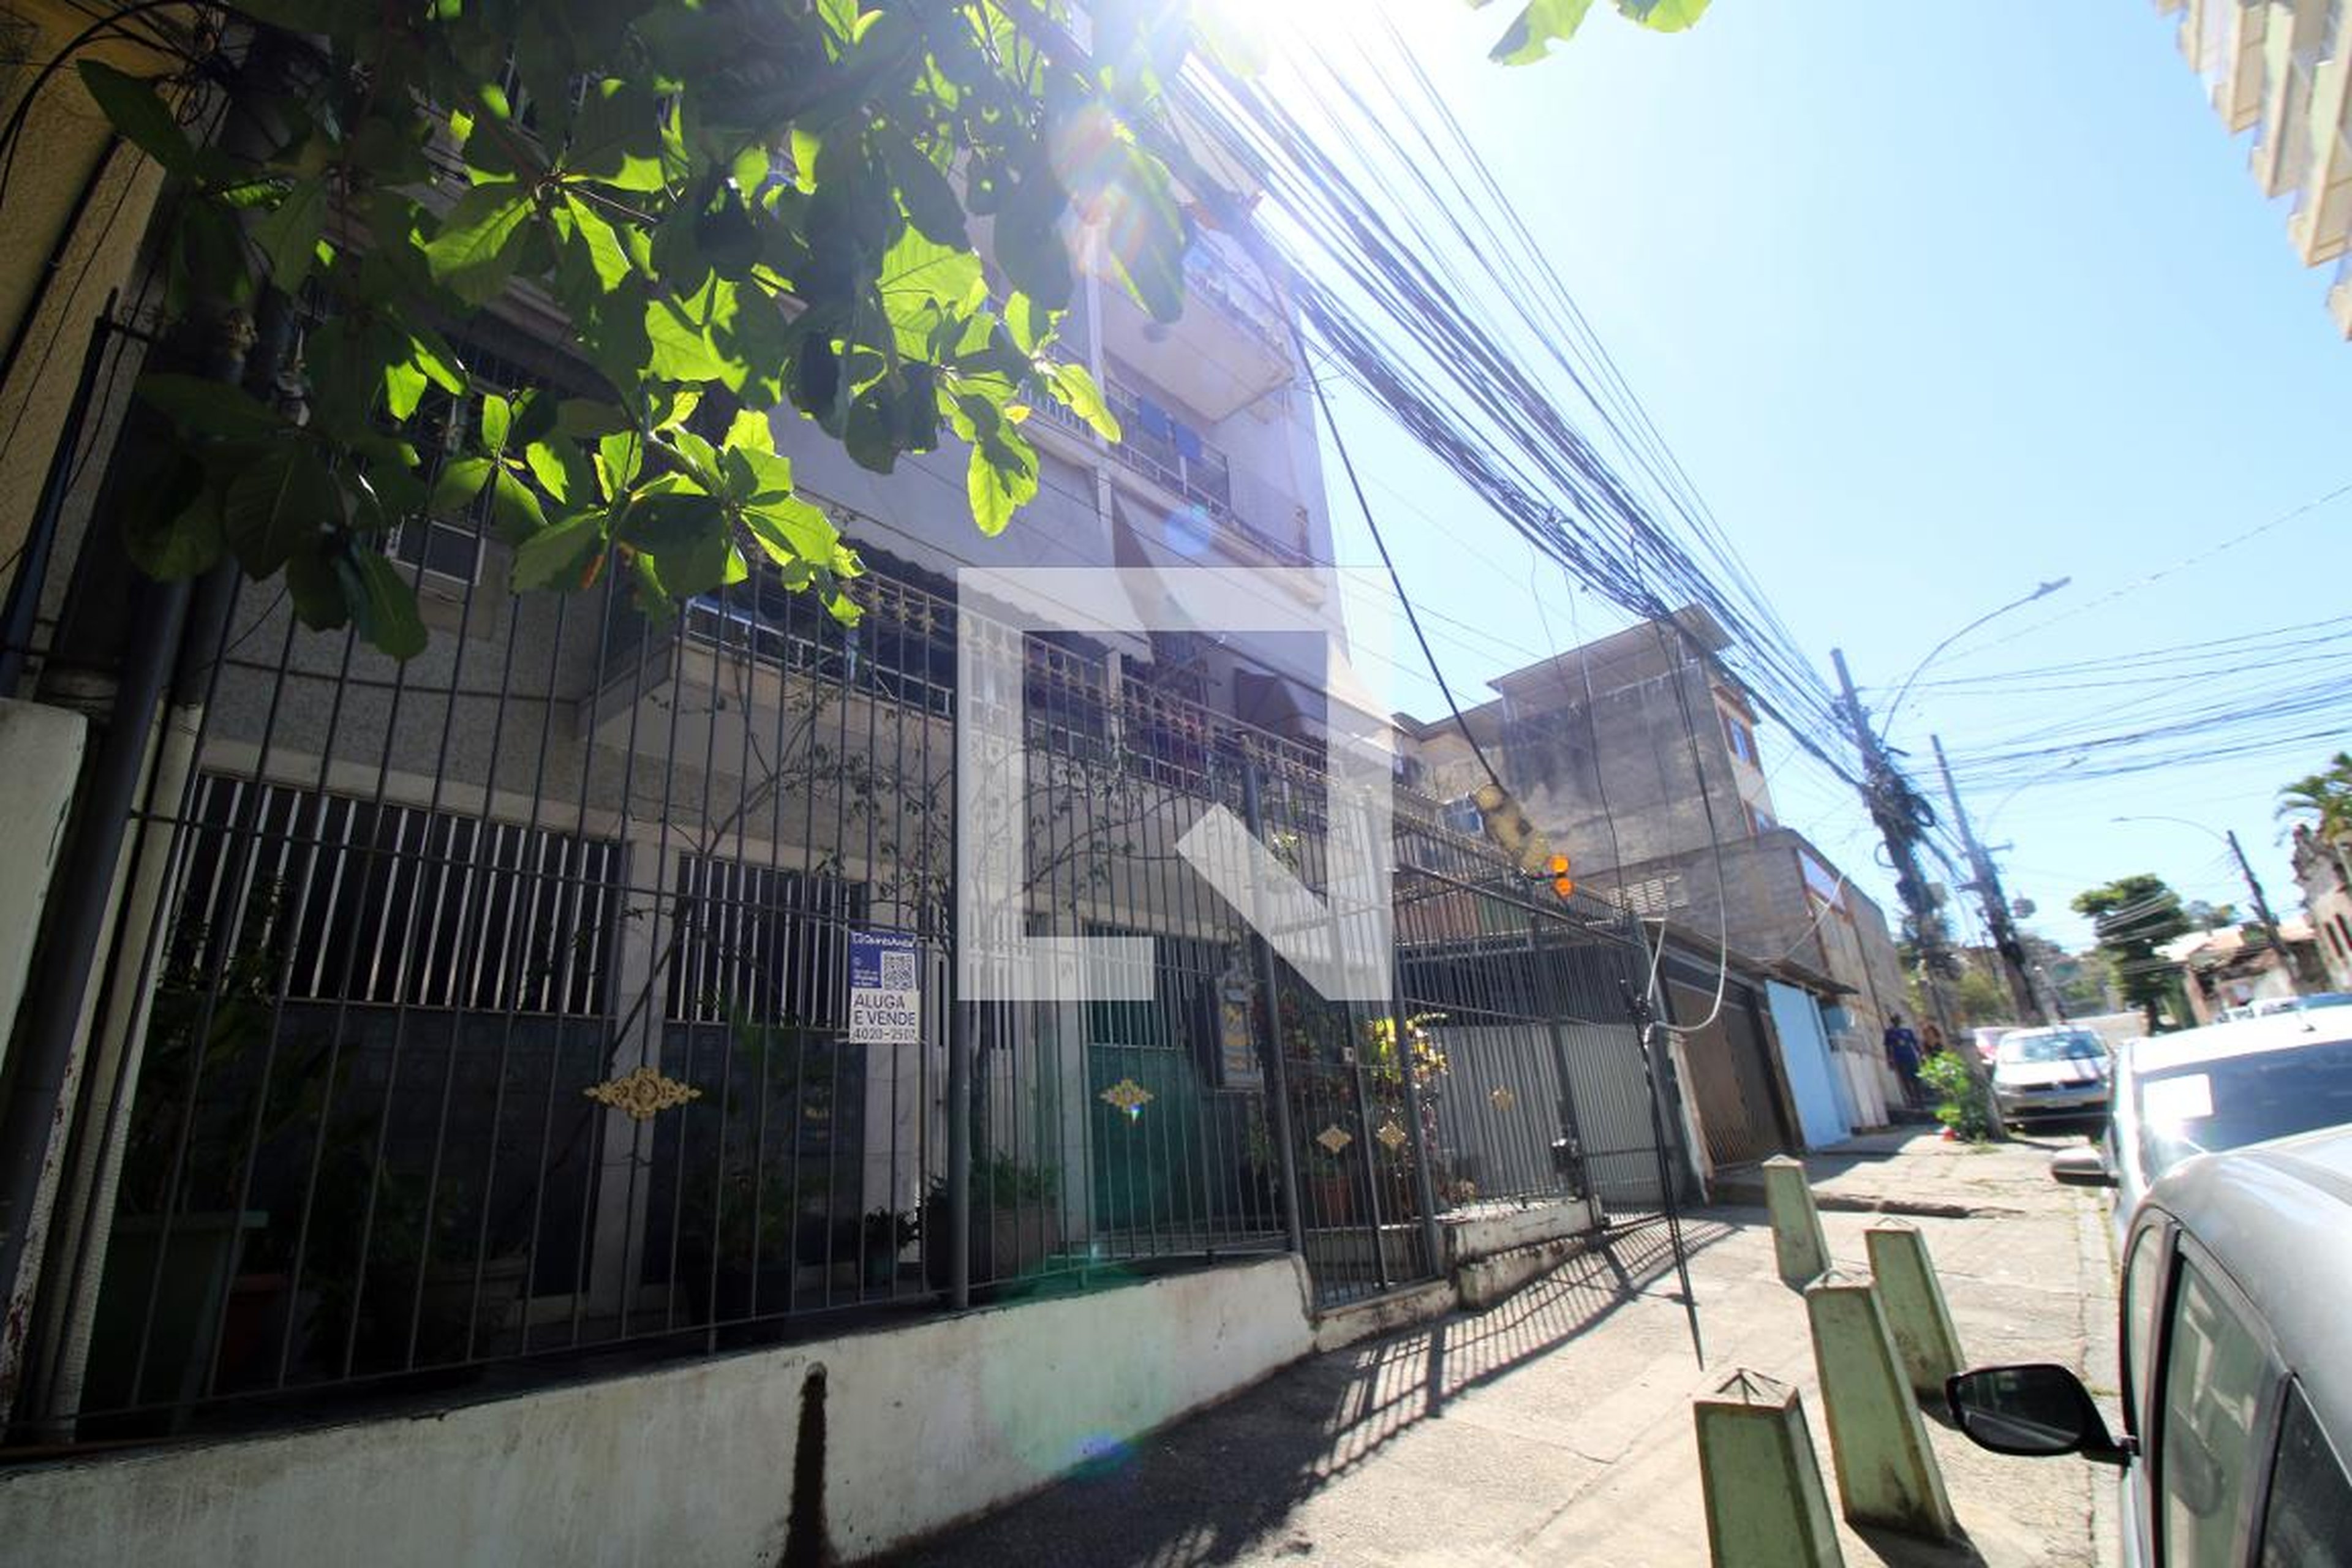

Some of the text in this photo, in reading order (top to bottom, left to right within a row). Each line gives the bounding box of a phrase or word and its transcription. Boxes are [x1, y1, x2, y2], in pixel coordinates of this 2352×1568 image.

[854, 993, 905, 1009] ALUGA
[854, 1010, 916, 1026] E VENDE
